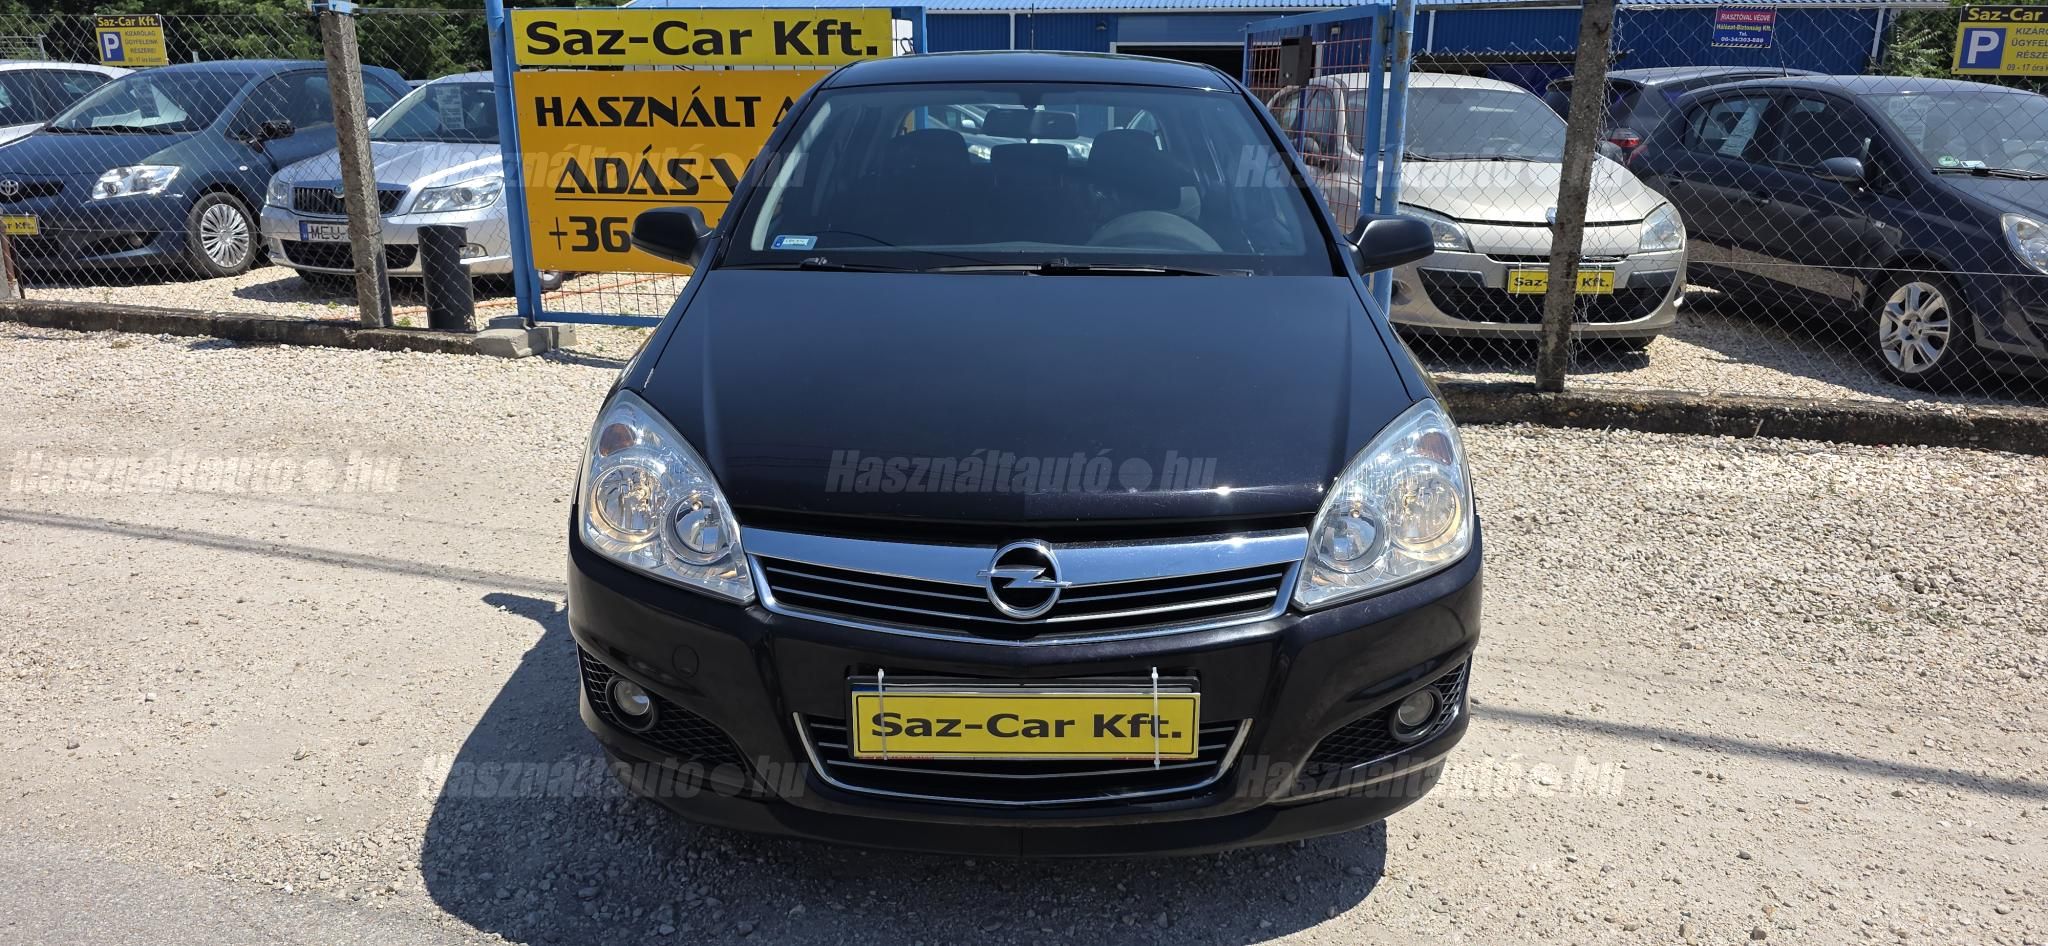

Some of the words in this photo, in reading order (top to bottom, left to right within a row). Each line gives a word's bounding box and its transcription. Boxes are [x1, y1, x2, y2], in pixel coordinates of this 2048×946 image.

[97, 16, 136, 27] Saz-Car
[138, 16, 159, 26] Kft.
[1967, 7, 2044, 21] Saz-Car
[103, 33, 120, 59] P
[526, 20, 753, 56] Saz-Car
[773, 19, 879, 56] Kft.
[1967, 30, 2000, 65] P
[535, 86, 762, 128] HASZNÁLT
[310, 225, 352, 240] MEU-
[549, 215, 632, 254] +36
[1513, 276, 1548, 287] Saz-
[1582, 277, 1610, 287] Kft.
[871, 712, 1076, 738] Saz-Car
[1093, 711, 1183, 739] Kft.
